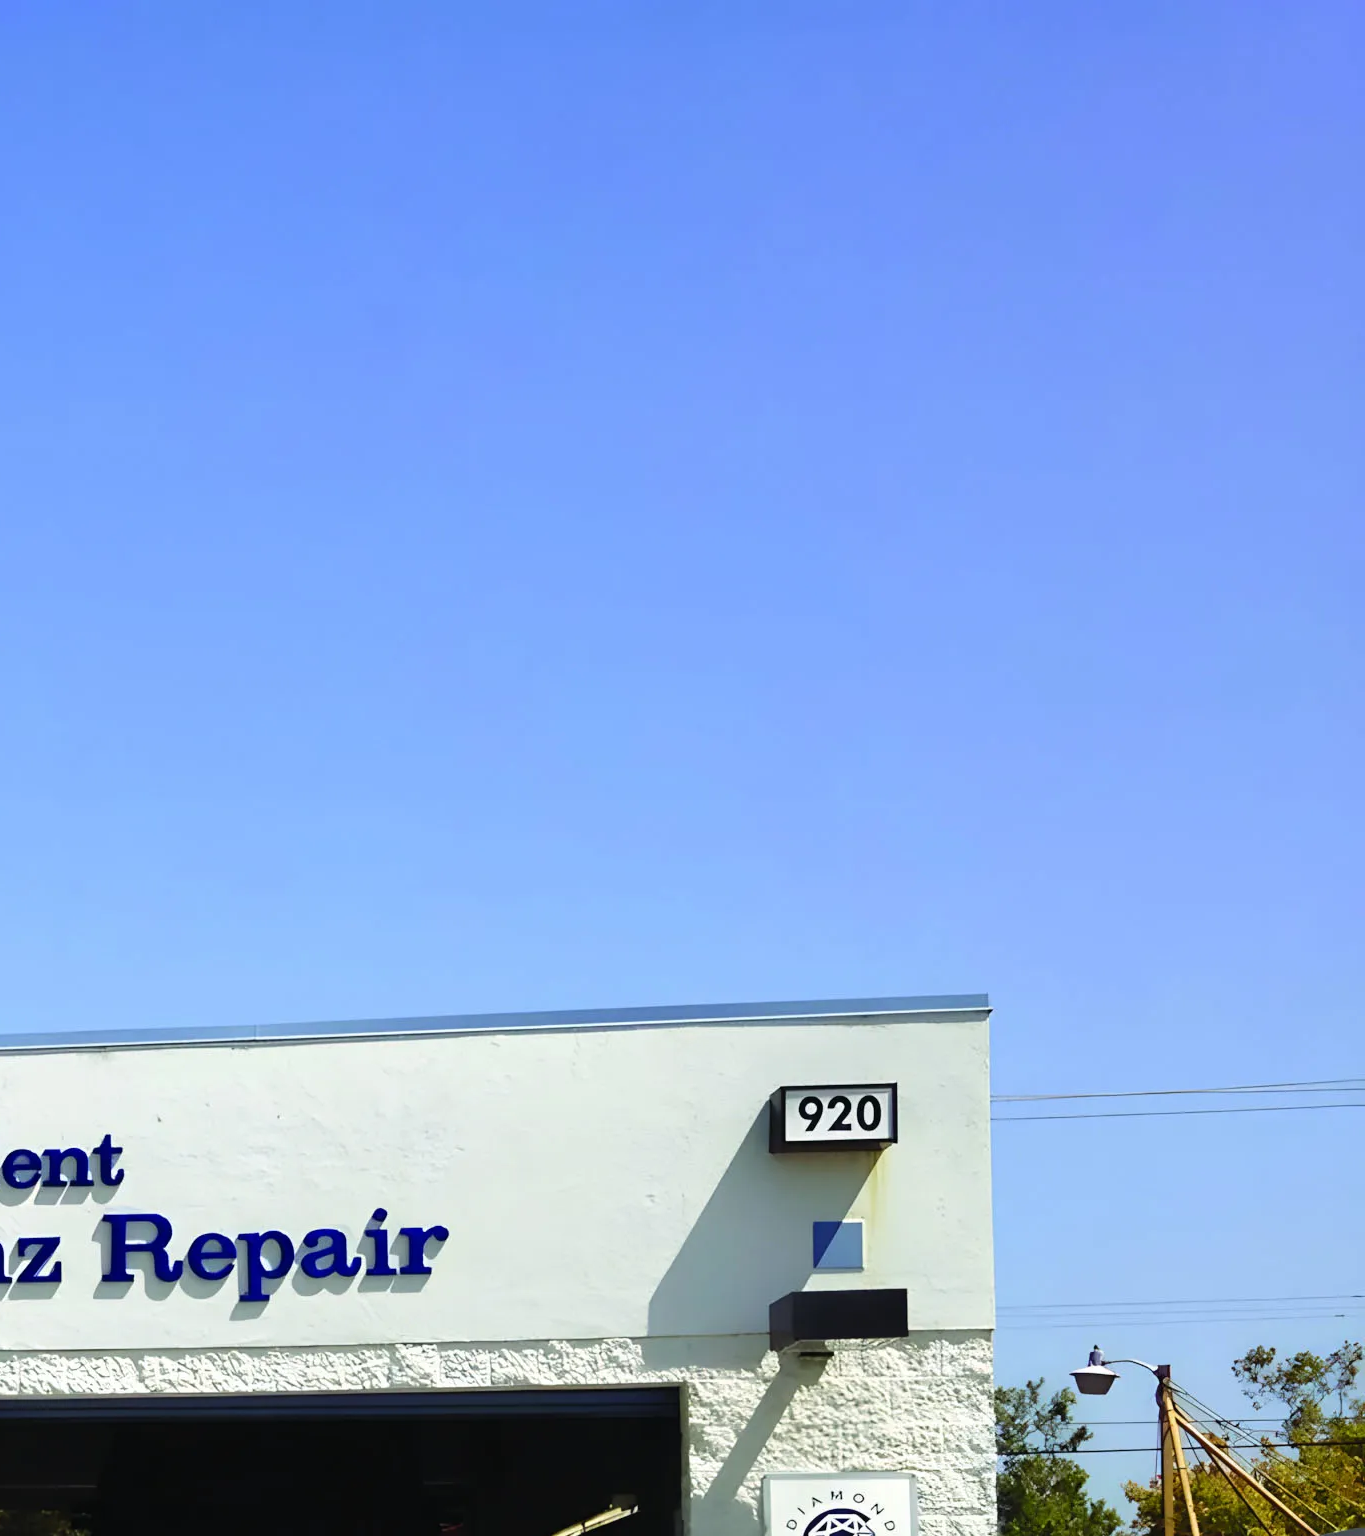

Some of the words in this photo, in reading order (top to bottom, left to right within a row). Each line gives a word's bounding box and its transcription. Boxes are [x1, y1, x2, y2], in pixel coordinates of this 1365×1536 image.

[798, 1094, 882, 1132] 920
[101, 1208, 450, 1303] Repair
[785, 1490, 897, 1532] DIAMOND
